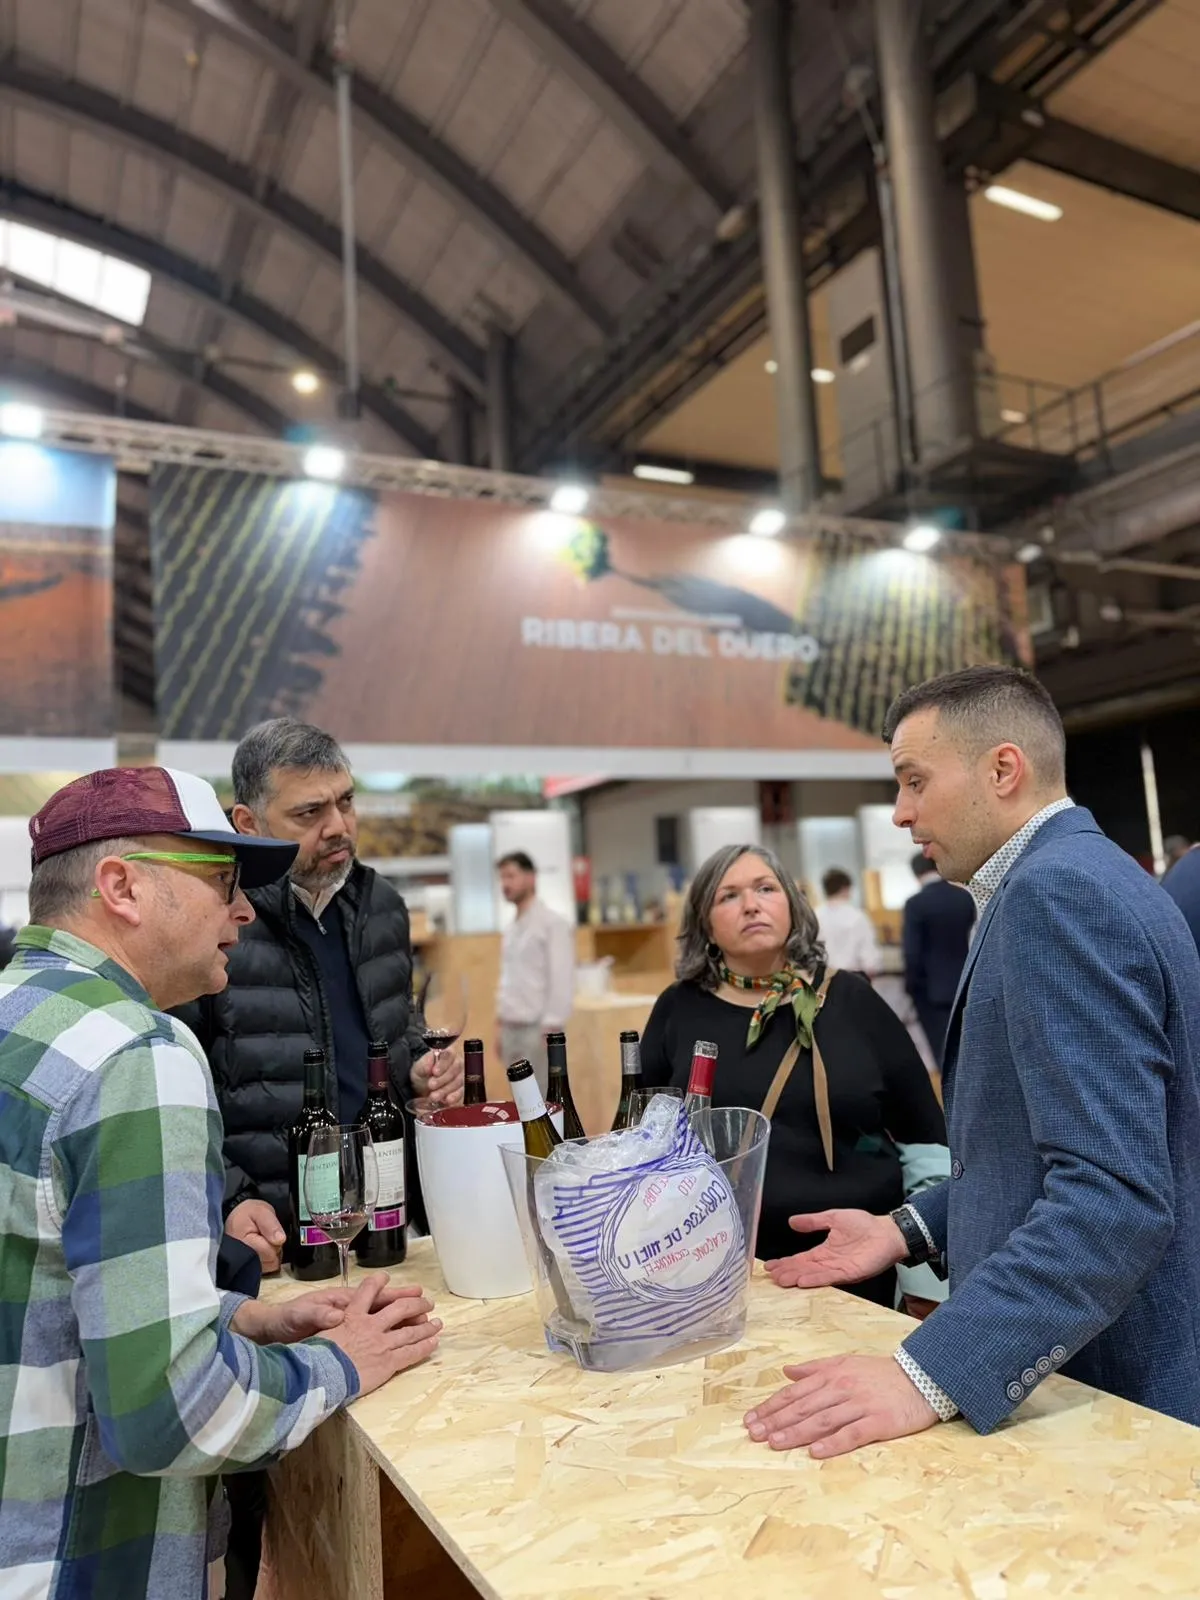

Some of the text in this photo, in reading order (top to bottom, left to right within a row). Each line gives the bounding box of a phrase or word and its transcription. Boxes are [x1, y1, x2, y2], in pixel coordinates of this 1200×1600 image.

[522, 616, 643, 651] RIBERA
[653, 627, 710, 656] DEL
[718, 630, 818, 662] DUERO
[664, 1228, 682, 1249] DE
